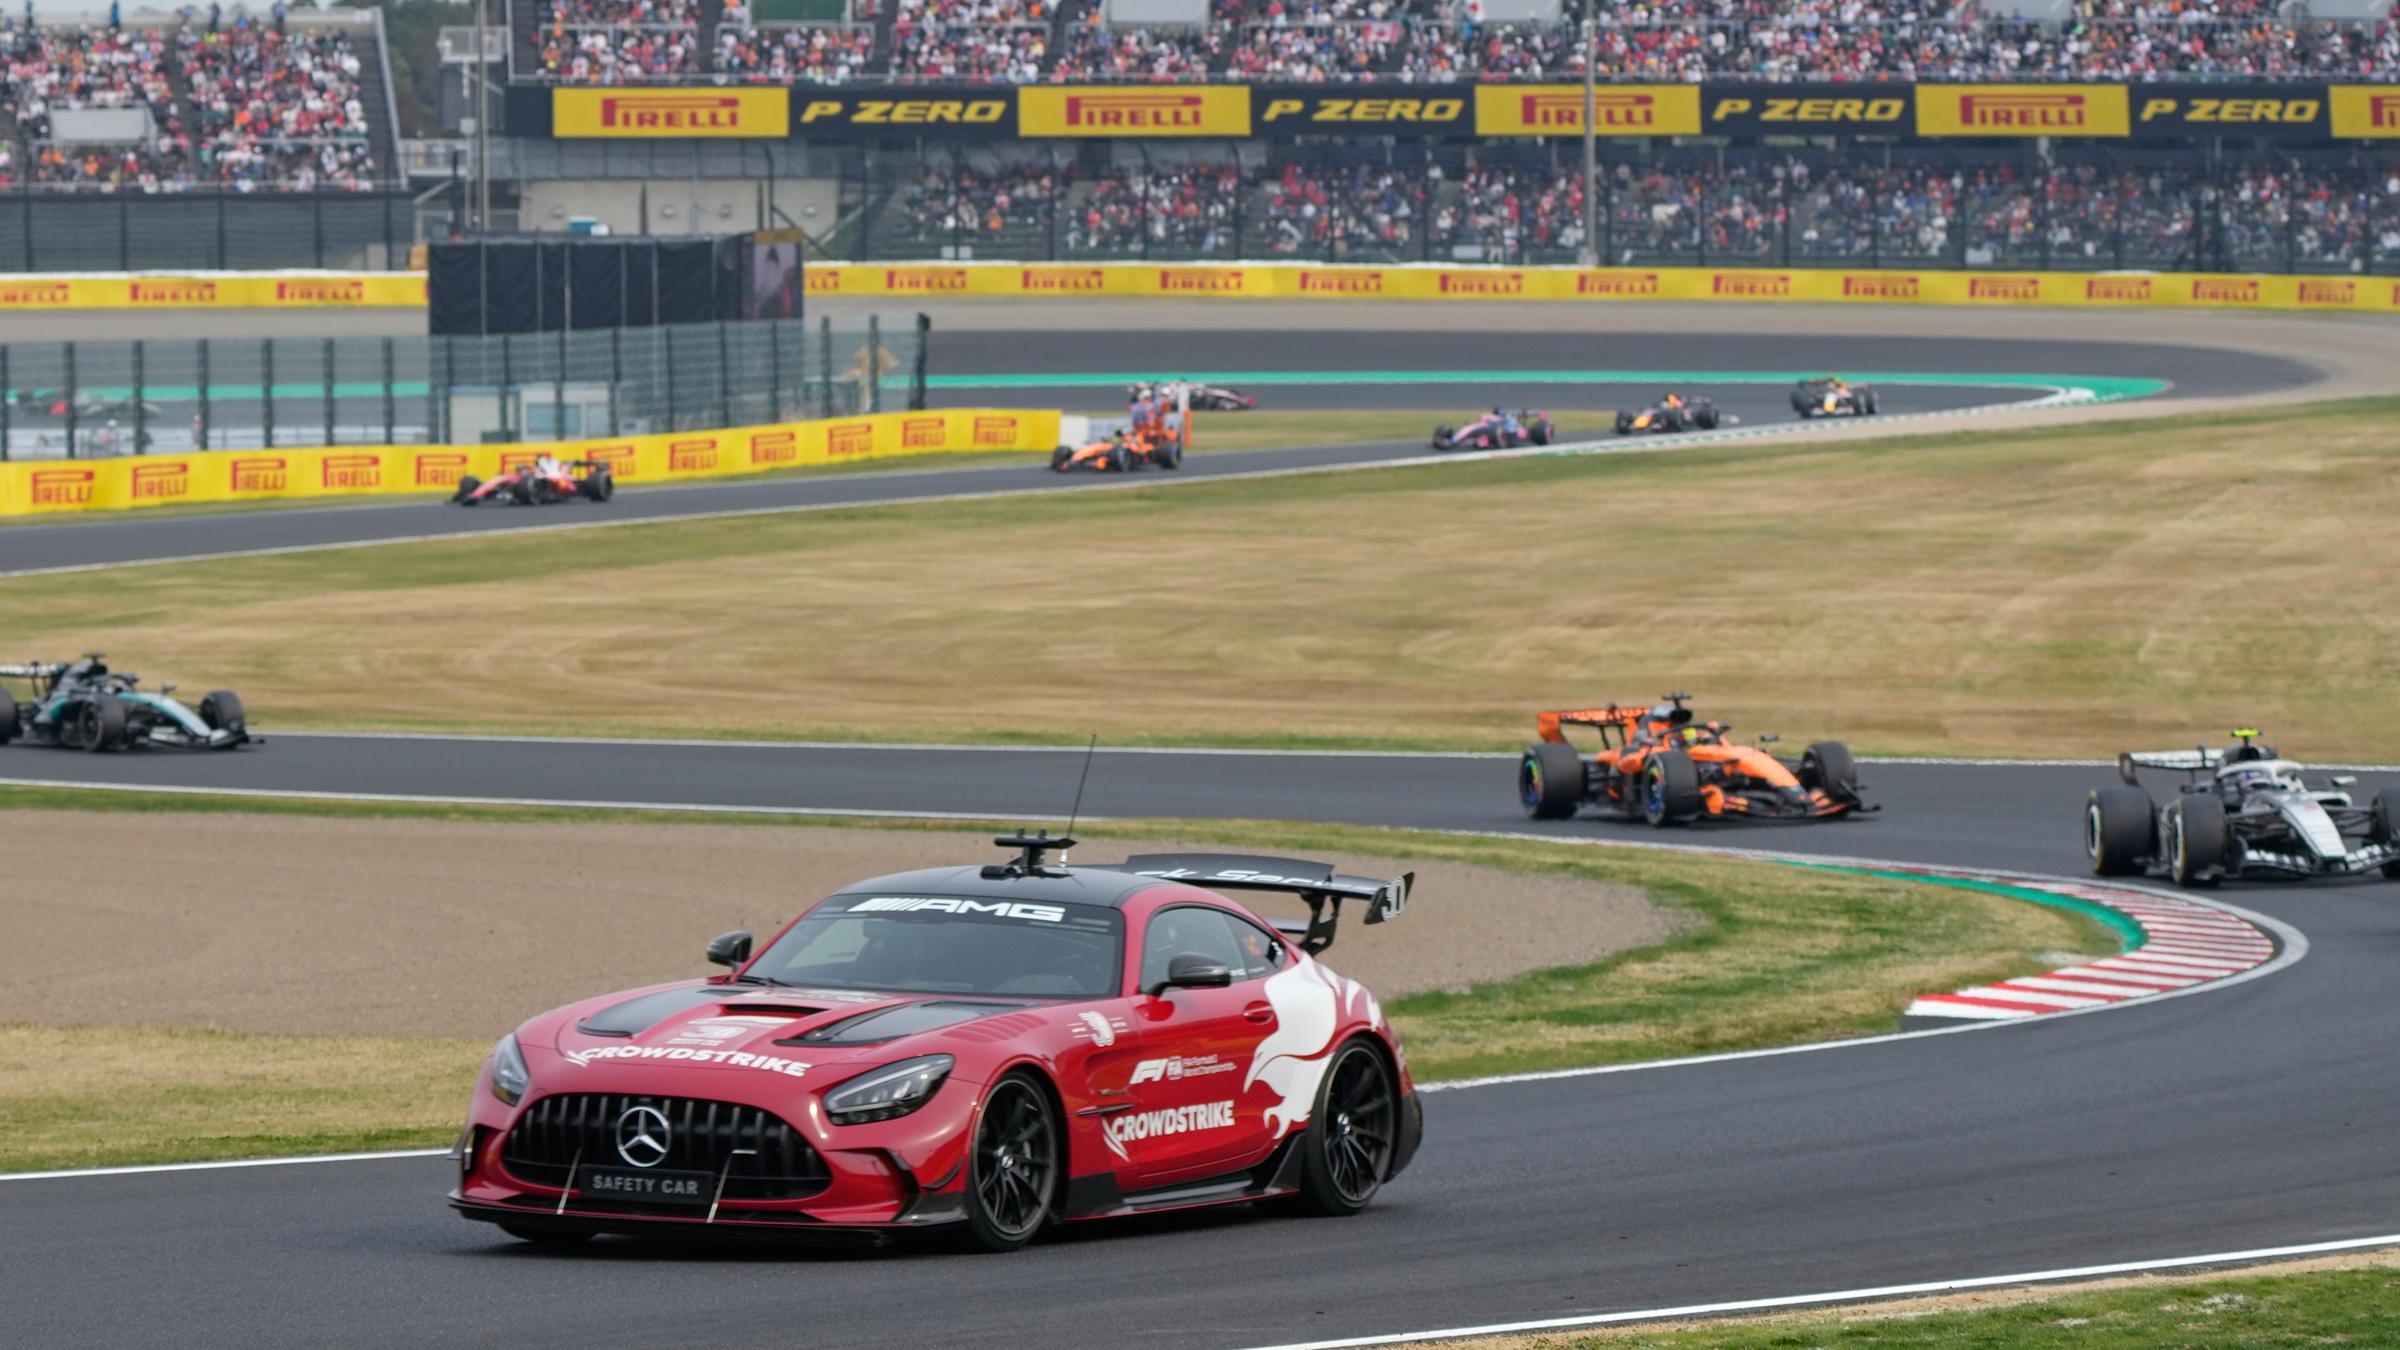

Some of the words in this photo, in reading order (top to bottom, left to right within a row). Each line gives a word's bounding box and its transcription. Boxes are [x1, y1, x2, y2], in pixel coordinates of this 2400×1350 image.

[600, 96, 741, 128] PIRELLI
[802, 101, 842, 123] P
[852, 101, 1006, 123] ZERO
[1064, 94, 1204, 127] PIRELLI
[1264, 100, 1303, 121] P
[1314, 100, 1463, 121] ZERO
[1714, 100, 1751, 120] P
[1762, 100, 1904, 121] ZERO
[1959, 94, 2086, 127] PIRELLI
[2142, 100, 2177, 121] P
[2187, 100, 2320, 122] ZERO
[1022, 269, 1105, 290] PIRELLI
[1159, 270, 1243, 290] PIRELLI
[1299, 271, 1383, 292] PIRELLI
[1438, 272, 1523, 293] PIRELLI
[1577, 274, 1659, 294] PIRELLI
[1712, 274, 1791, 295] PIRELLI
[1842, 276, 1920, 297] PIRELLI
[1968, 278, 2040, 299] PIRELLI
[2086, 279, 2152, 300] PIRELLI
[2192, 279, 2260, 301] PIRELLI
[0, 283, 69, 303] RELLI
[130, 283, 217, 302] PIRELLI
[277, 281, 364, 301] PIRELLI
[132, 463, 189, 498] PIRELLI
[231, 459, 287, 491] PIRELLI
[322, 456, 380, 487] PIRELLI
[32, 470, 95, 504] PIRELLI
[584, 1046, 813, 1077] CROWDSTRIKE
[1128, 1058, 1169, 1085] F1
[1111, 1100, 1236, 1142] CROWDSTRIKE
[592, 1175, 656, 1193] SAFETY
[661, 1180, 699, 1195] CAR
